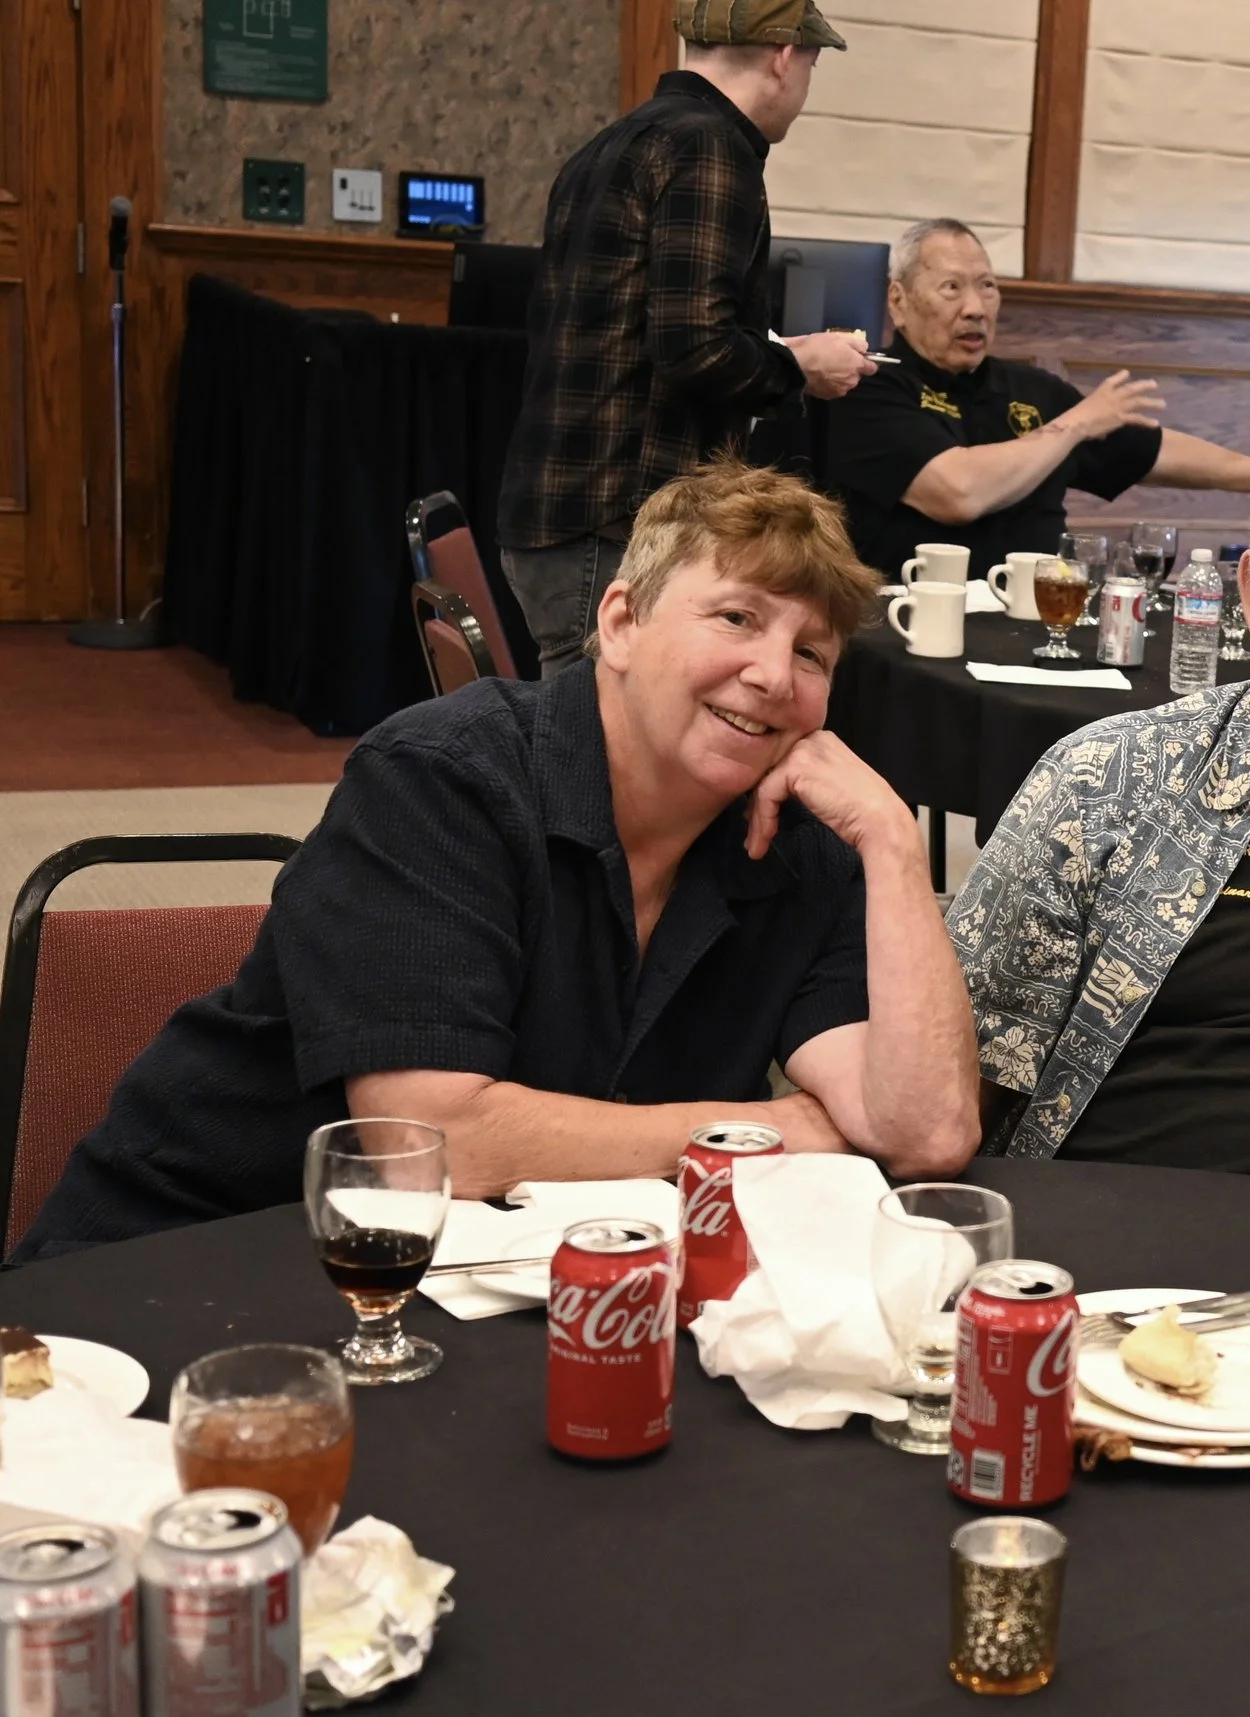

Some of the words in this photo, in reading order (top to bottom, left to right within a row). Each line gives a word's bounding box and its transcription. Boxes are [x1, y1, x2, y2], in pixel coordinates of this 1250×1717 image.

[601, 1352, 642, 1365] TASTE
[1023, 1404, 1038, 1430] ME
[1019, 1431, 1037, 1501] RECYCLE
